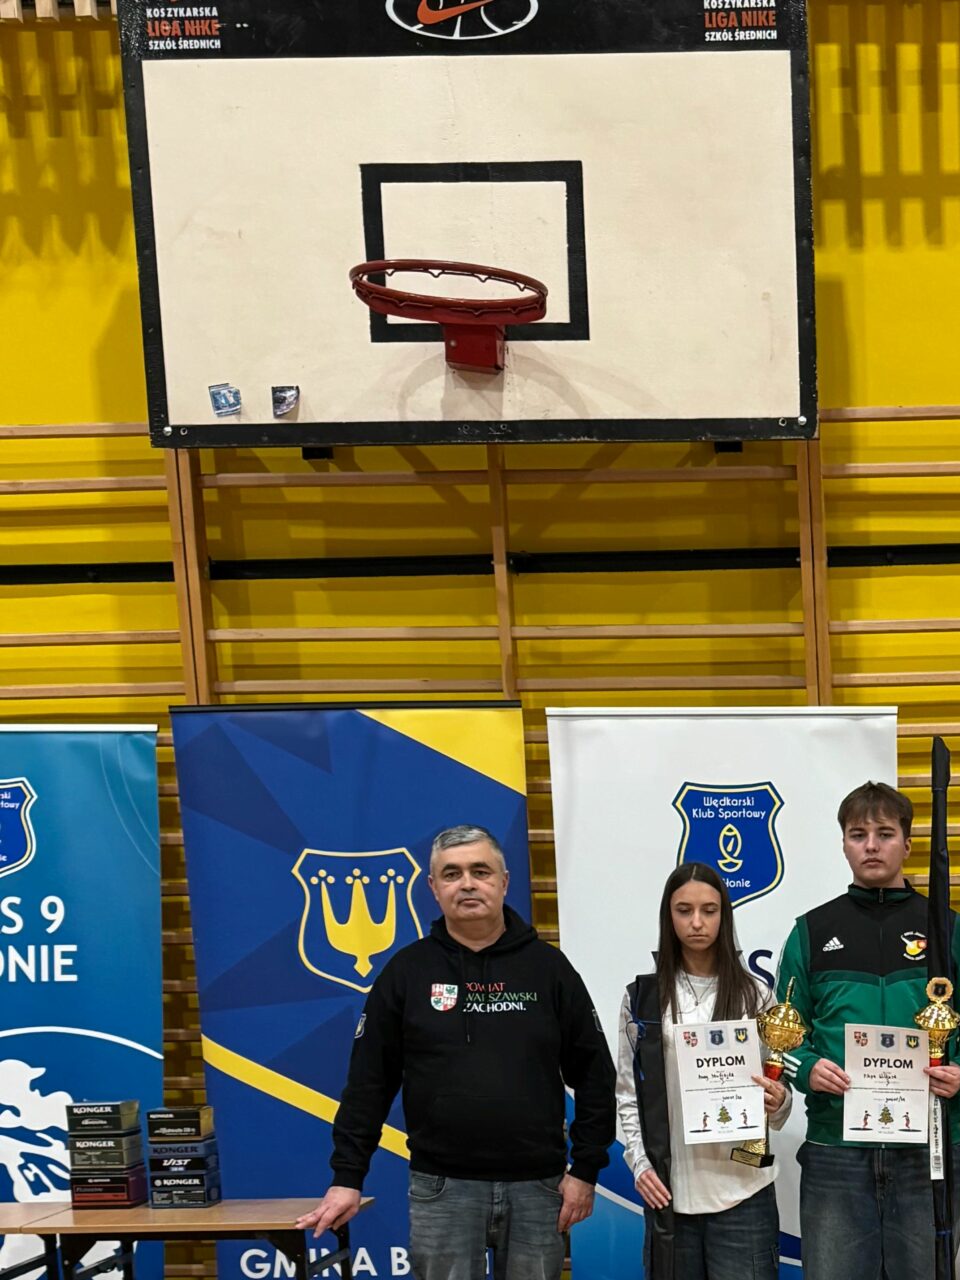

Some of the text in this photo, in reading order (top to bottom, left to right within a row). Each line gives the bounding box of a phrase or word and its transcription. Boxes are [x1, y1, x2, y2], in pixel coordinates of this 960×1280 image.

[704, 0, 776, 9] KOSZYKARSKA
[146, 7, 218, 18] KOSZYKARSKA
[704, 11, 776, 28] LIGA NIKE
[147, 20, 219, 37] LIGA NIKE
[705, 28, 777, 41] SZKÓŁ ŚREDNICH
[148, 37, 221, 50] SZKÓŁ ŚREDNICH
[703, 796, 755, 808] Wędkarski
[692, 808, 766, 819] Klub Sportowy
[723, 878, 751, 888] łonie
[40, 896, 65, 934] 9
[0, 944, 78, 983] NIE
[696, 1055, 746, 1068] DYPLOM
[863, 1057, 913, 1069] DYPLOM
[73, 1106, 112, 1114] KONGER
[152, 1146, 198, 1154] KONGER
[163, 1178, 201, 1186] KONGER
